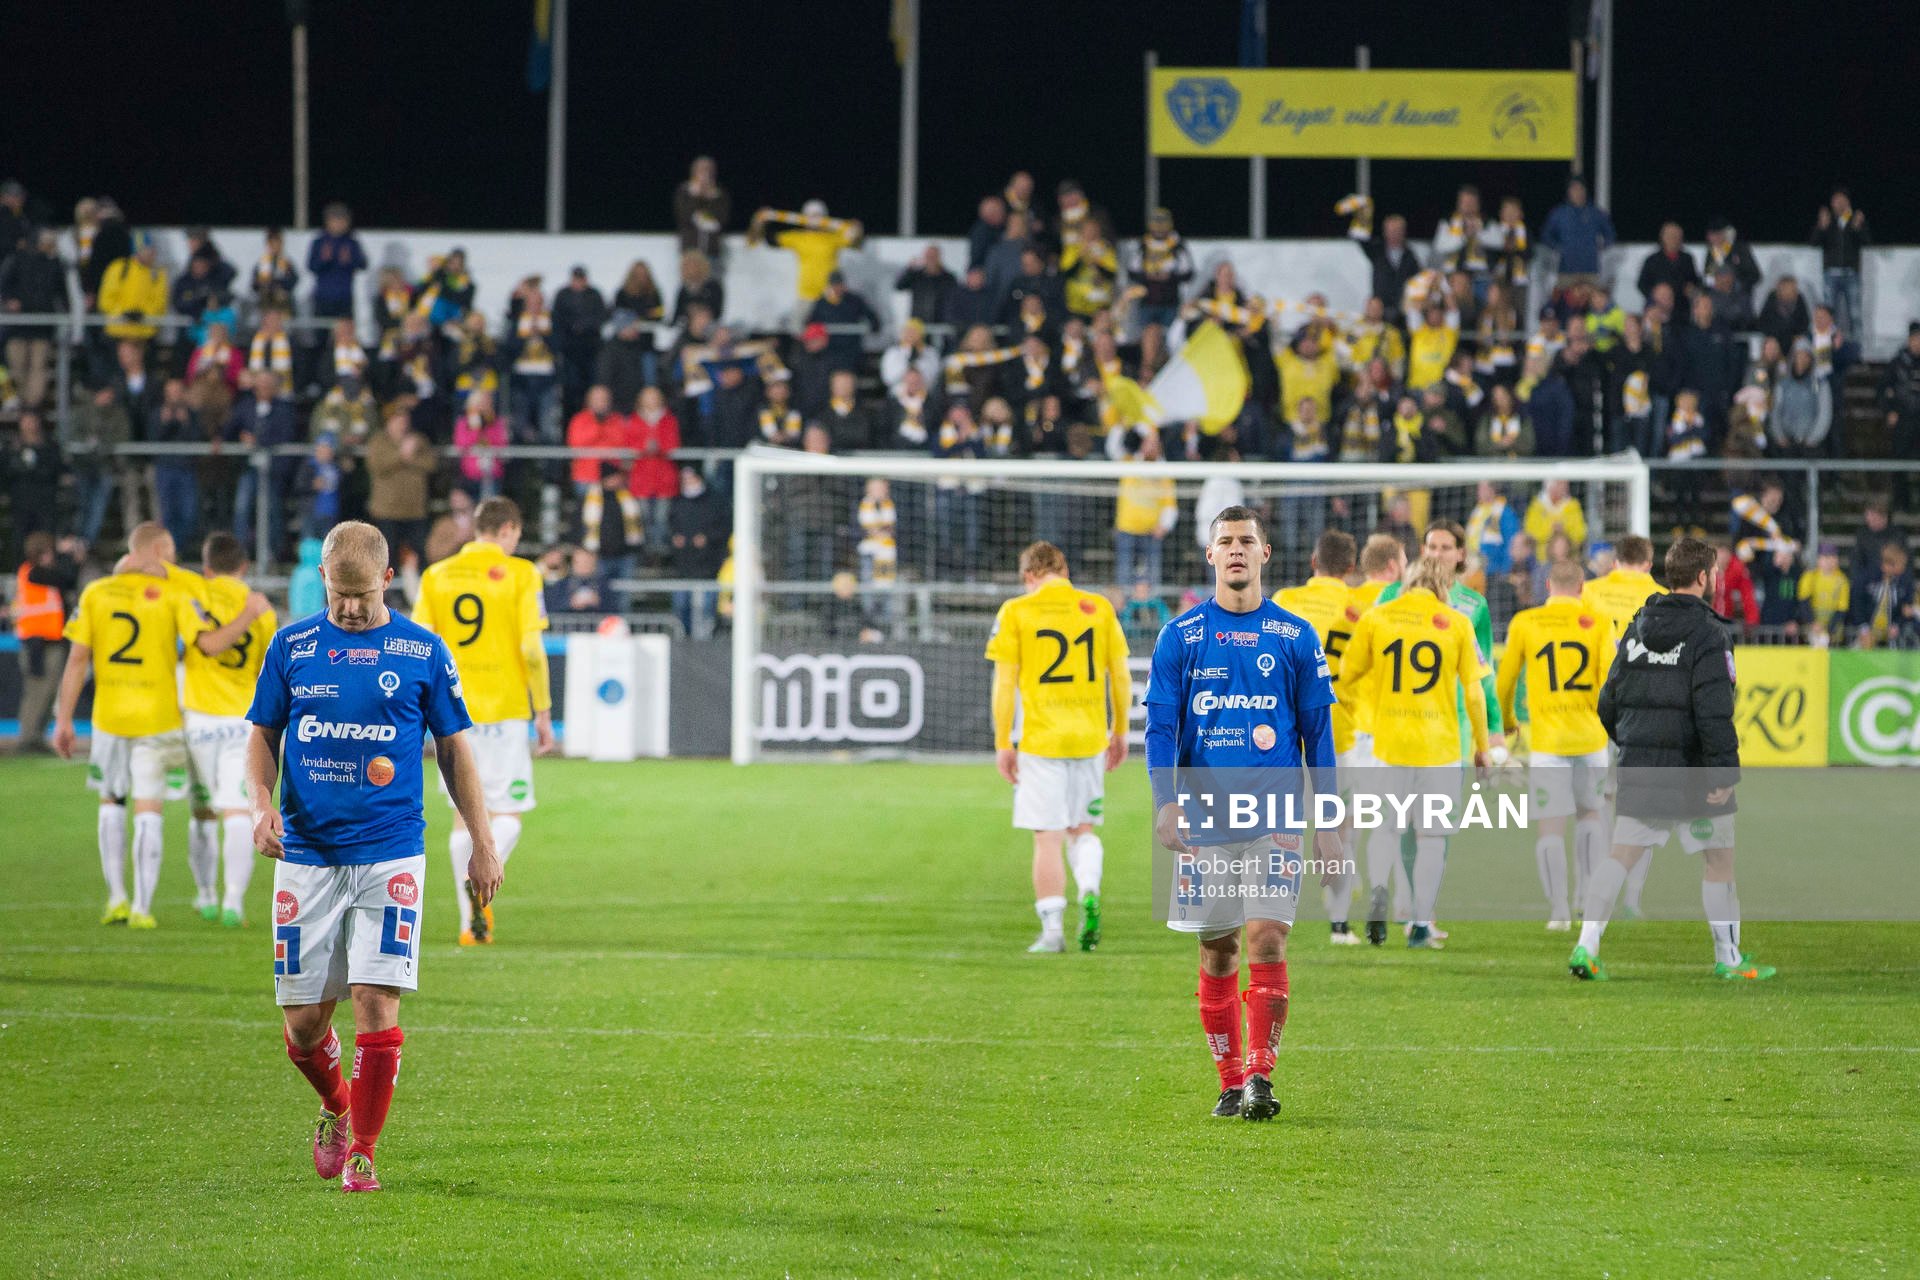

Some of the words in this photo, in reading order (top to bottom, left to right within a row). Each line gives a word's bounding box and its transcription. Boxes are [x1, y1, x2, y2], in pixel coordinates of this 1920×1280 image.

[453, 593, 484, 647] 9
[1176, 613, 1204, 628] uhlsport
[109, 612, 143, 665] 2
[286, 625, 320, 643] uhlsport
[348, 648, 378, 658] INTER
[383, 640, 432, 657] LEGENDS
[1036, 627, 1096, 684] 21
[348, 657, 377, 665] SPORT
[1382, 638, 1442, 694] 19
[1535, 641, 1593, 692] 12
[291, 684, 339, 697] MINEC
[1192, 690, 1278, 715] CONRAD
[297, 714, 397, 743] CONRAD
[1858, 691, 1920, 752] C
[1203, 737, 1245, 750] Sparbank
[308, 769, 356, 783] Sparbank
[393, 882, 415, 898] mix
